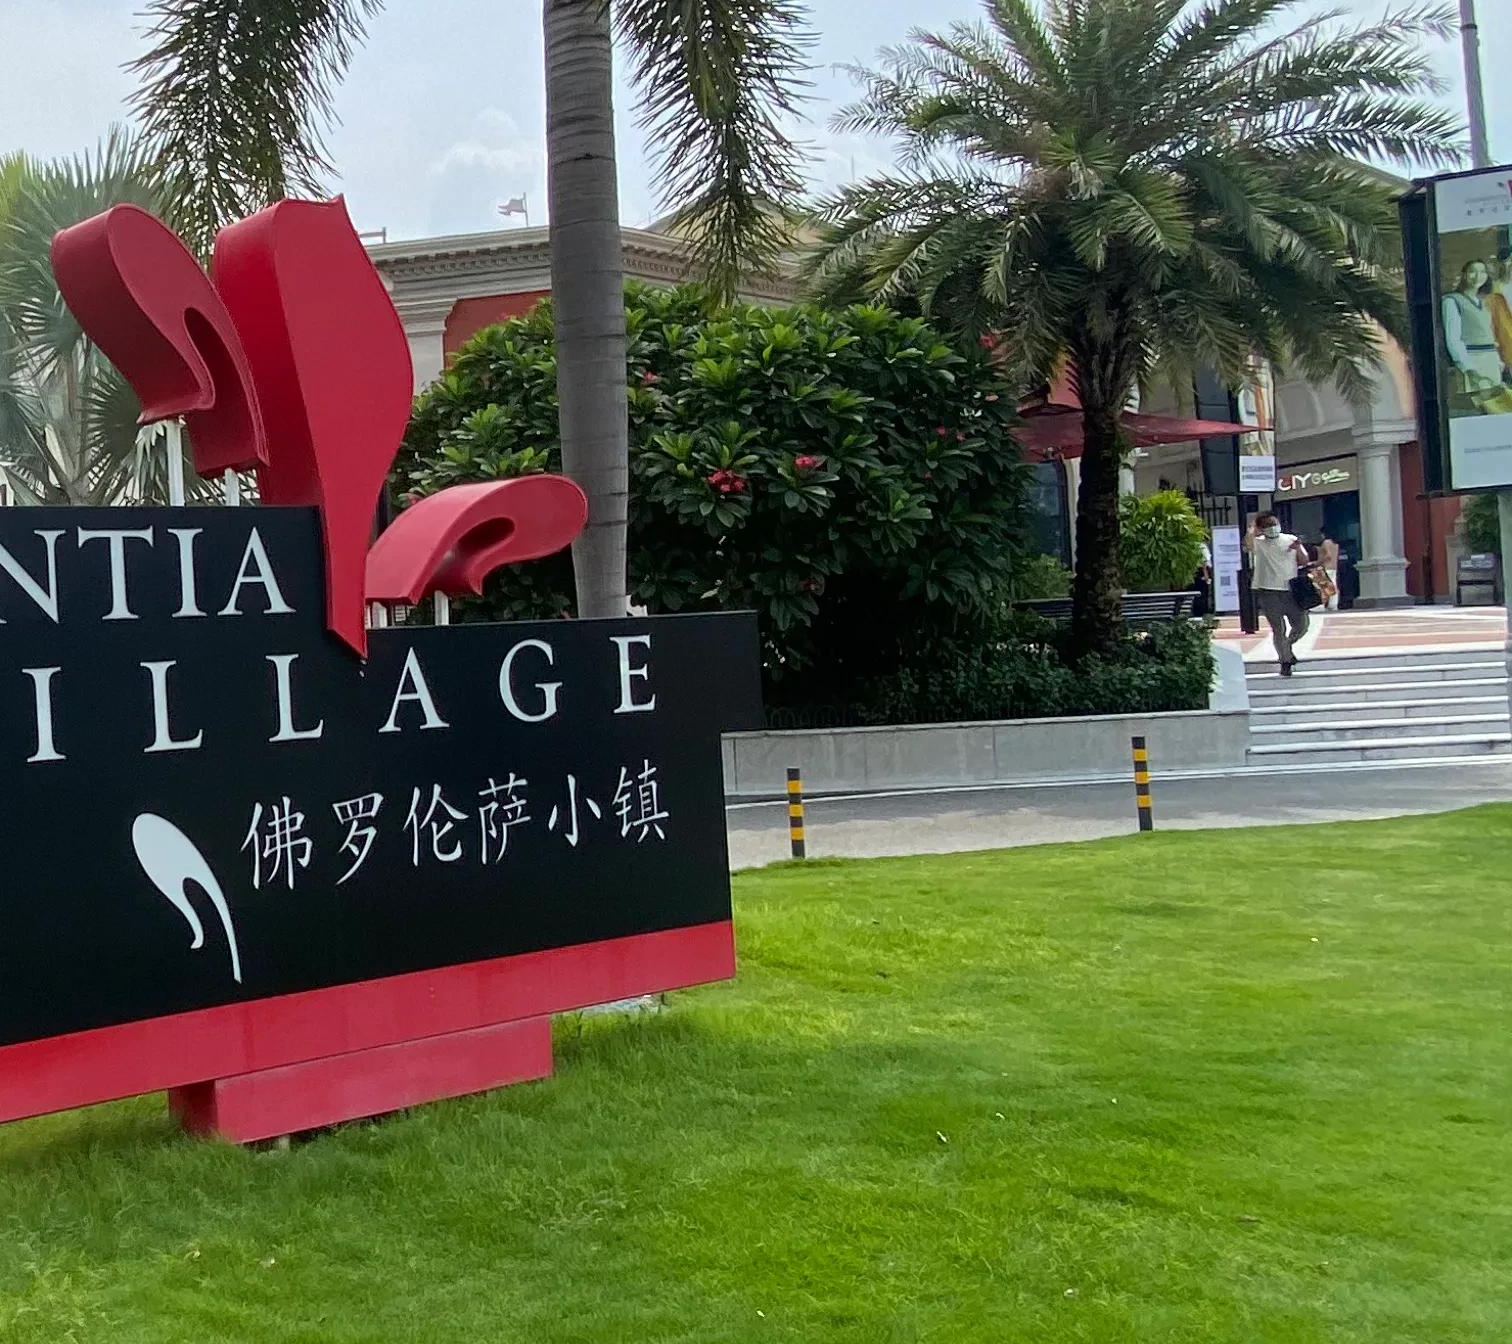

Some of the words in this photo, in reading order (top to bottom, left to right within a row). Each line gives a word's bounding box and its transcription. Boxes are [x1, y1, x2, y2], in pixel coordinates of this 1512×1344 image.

[239, 757, 672, 891] 佛罗伦萨小镇
